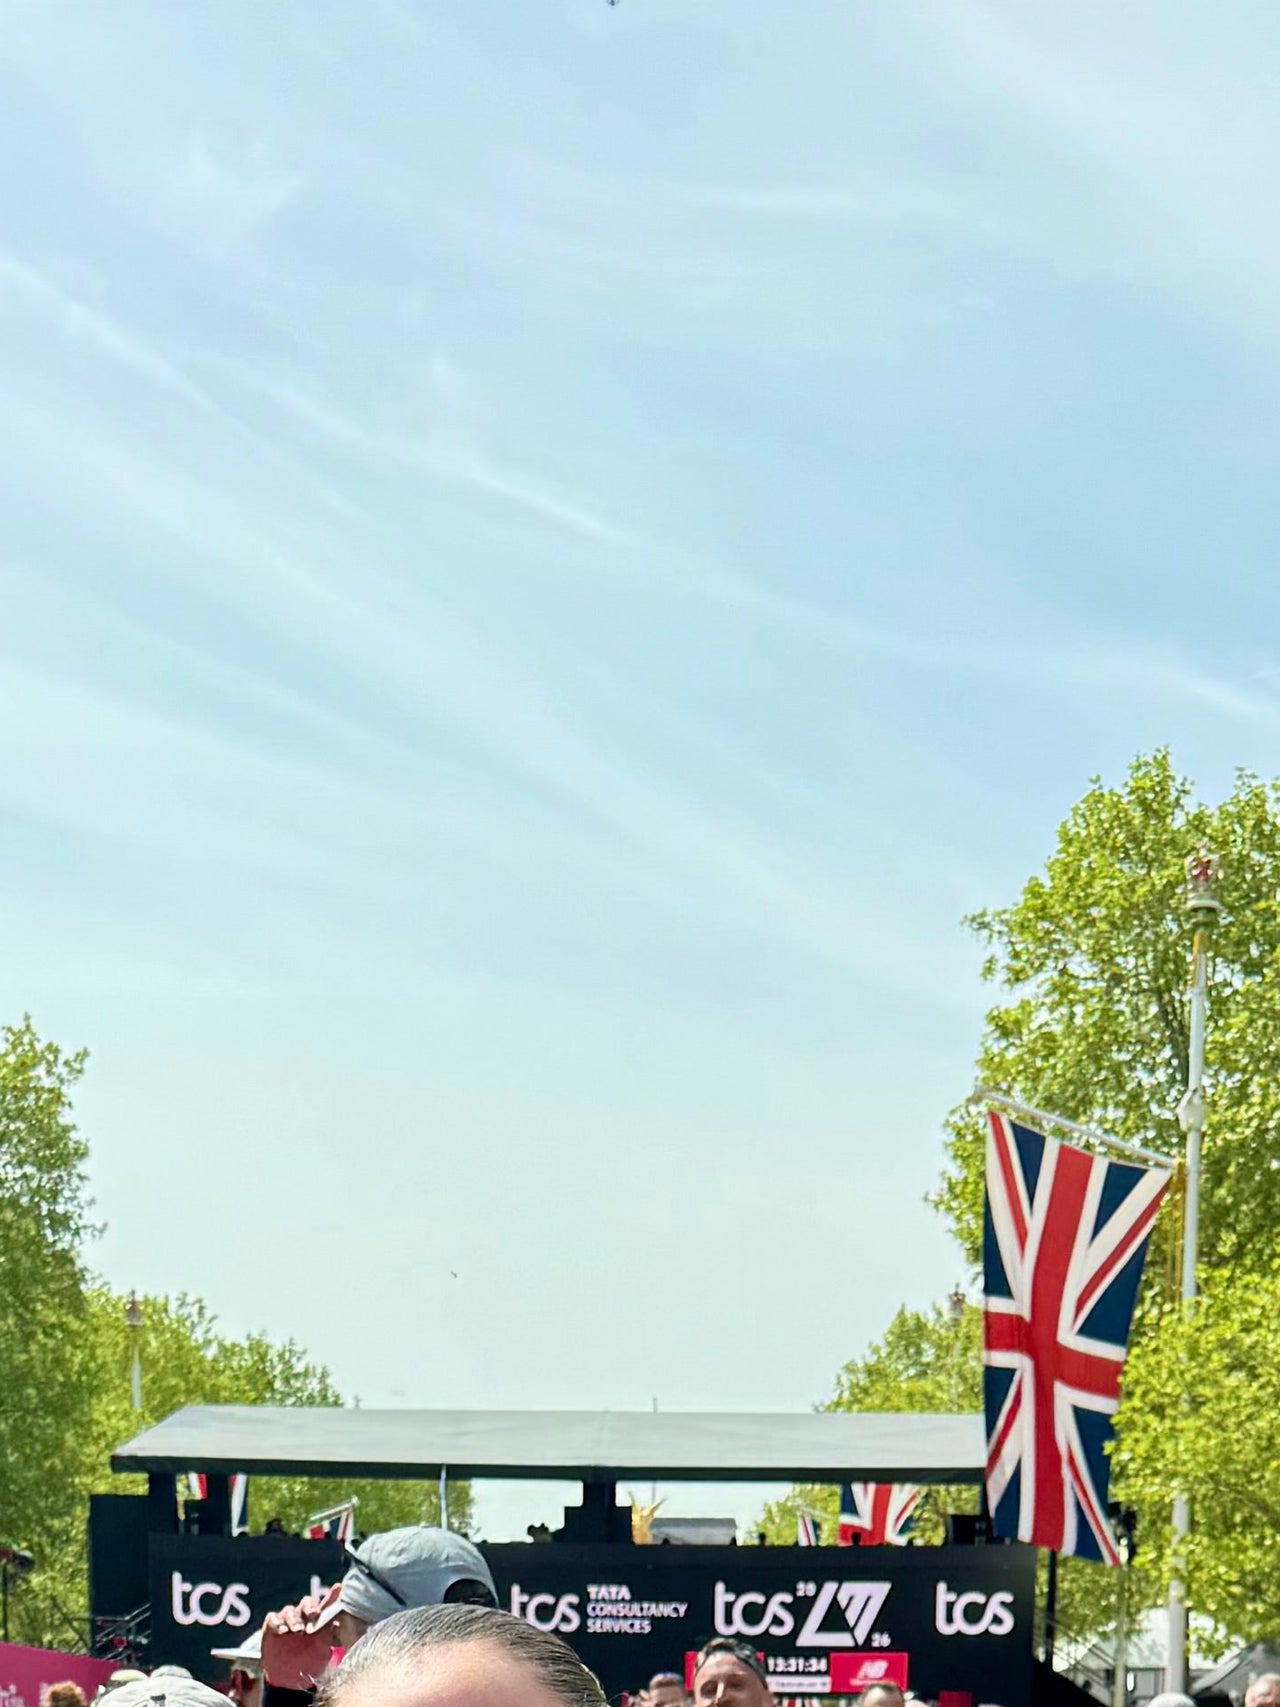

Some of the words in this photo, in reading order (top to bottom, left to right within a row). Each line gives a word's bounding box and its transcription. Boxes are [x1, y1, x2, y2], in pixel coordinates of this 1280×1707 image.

[171, 1571, 251, 1626] tcs
[511, 1583, 580, 1632] tcs
[586, 1584, 631, 1600] TATA
[586, 1602, 688, 1618] CONSULTANCY
[714, 1581, 794, 1636] tcs
[935, 1581, 1015, 1636] tcs
[586, 1619, 652, 1634] SERVICES
